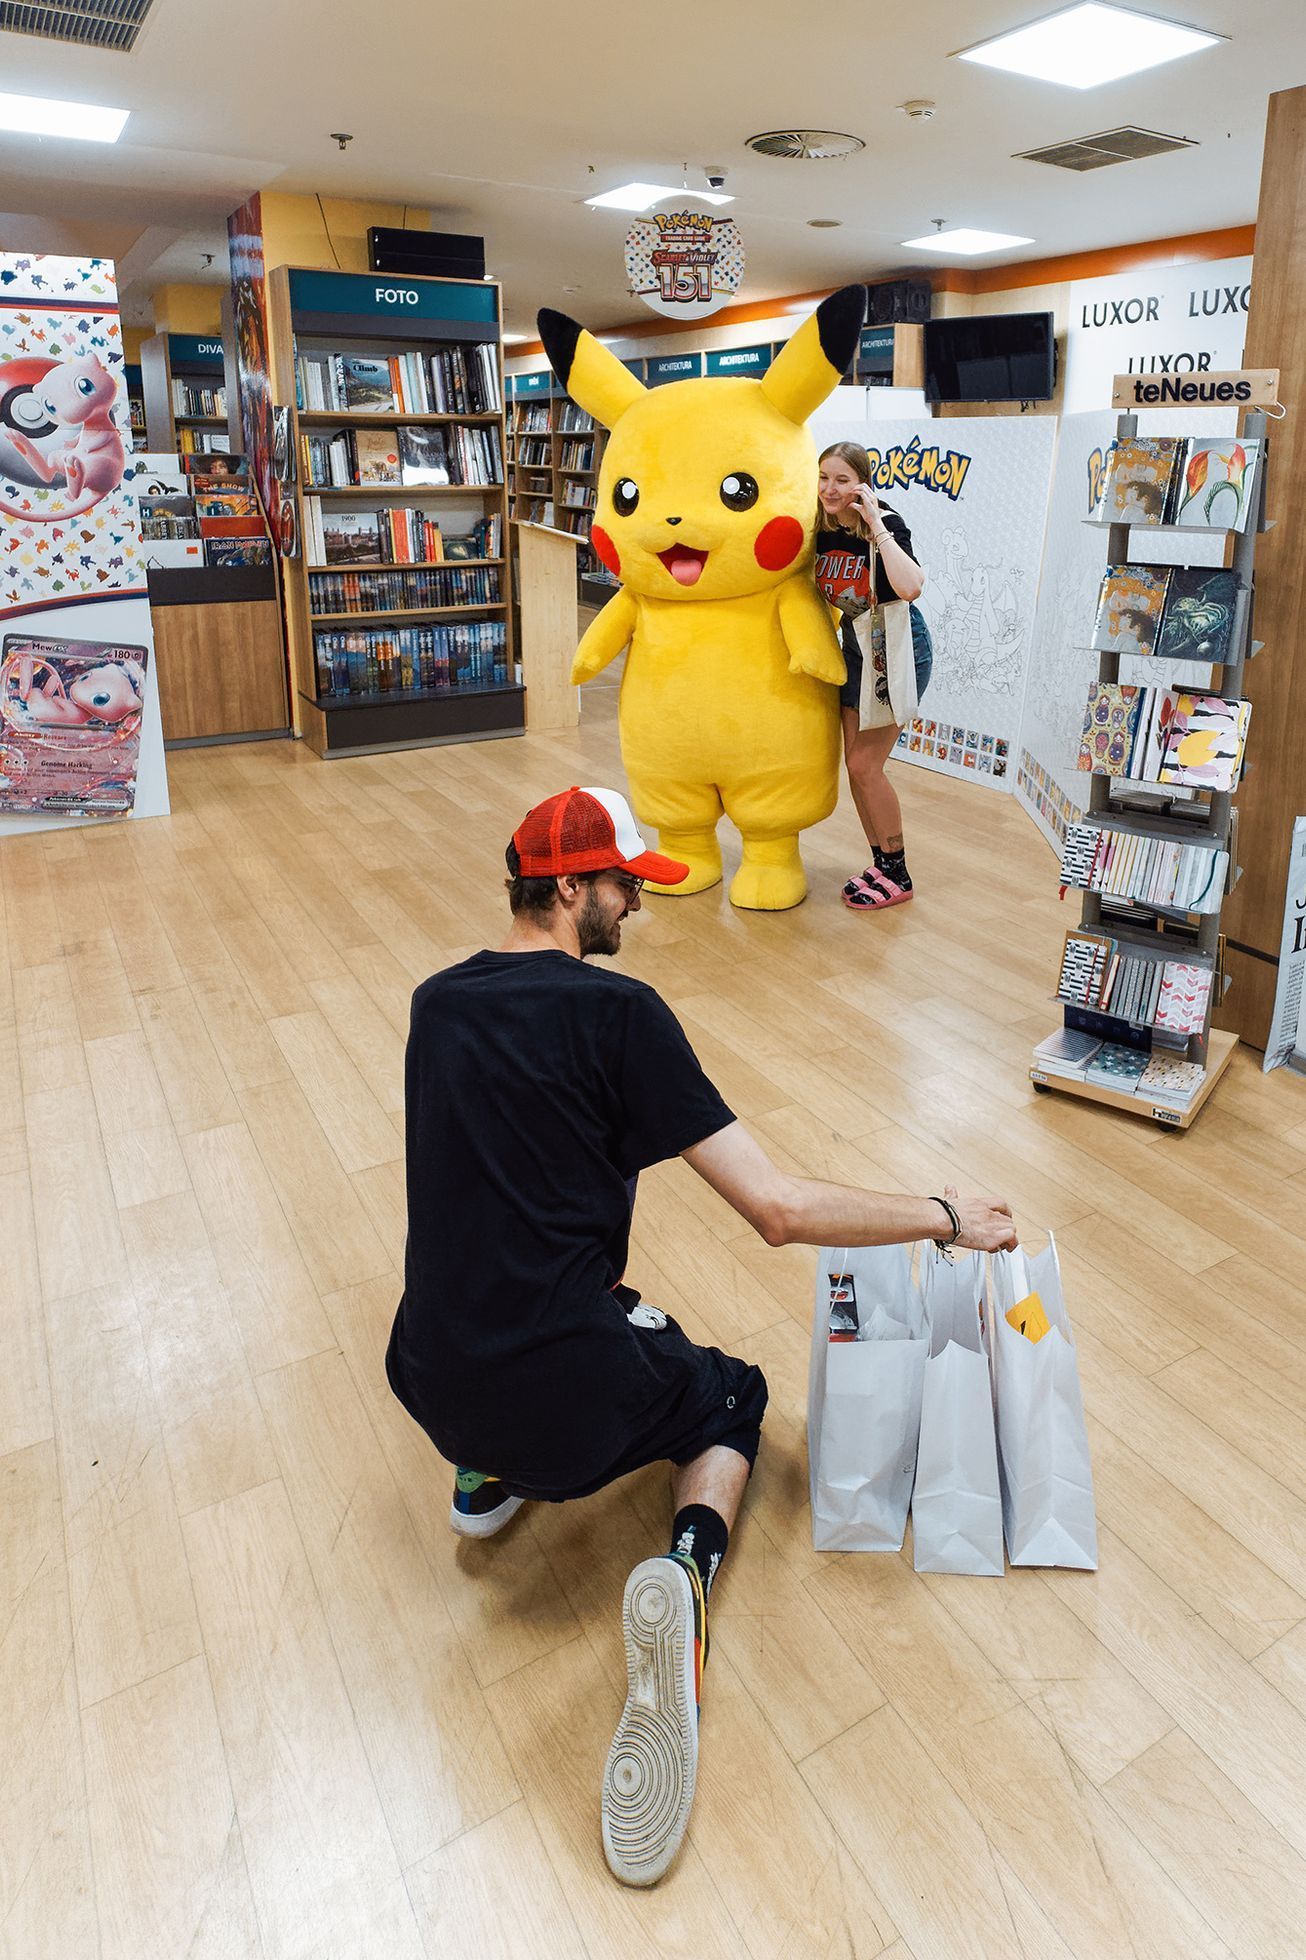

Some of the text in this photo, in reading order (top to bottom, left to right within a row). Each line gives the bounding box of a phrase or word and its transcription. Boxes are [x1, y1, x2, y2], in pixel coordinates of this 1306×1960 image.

[656, 263, 712, 302] 151
[375, 288, 419, 305] FOTO
[1082, 296, 1160, 328] LUXOR
[658, 360, 693, 372] ARCHITEKTURA
[719, 352, 760, 366] ARCHITEKTURA
[353, 364, 378, 373] Climb
[1133, 377, 1251, 402] teNeues
[32, 643, 52, 651] Mew
[114, 649, 131, 659] 180
